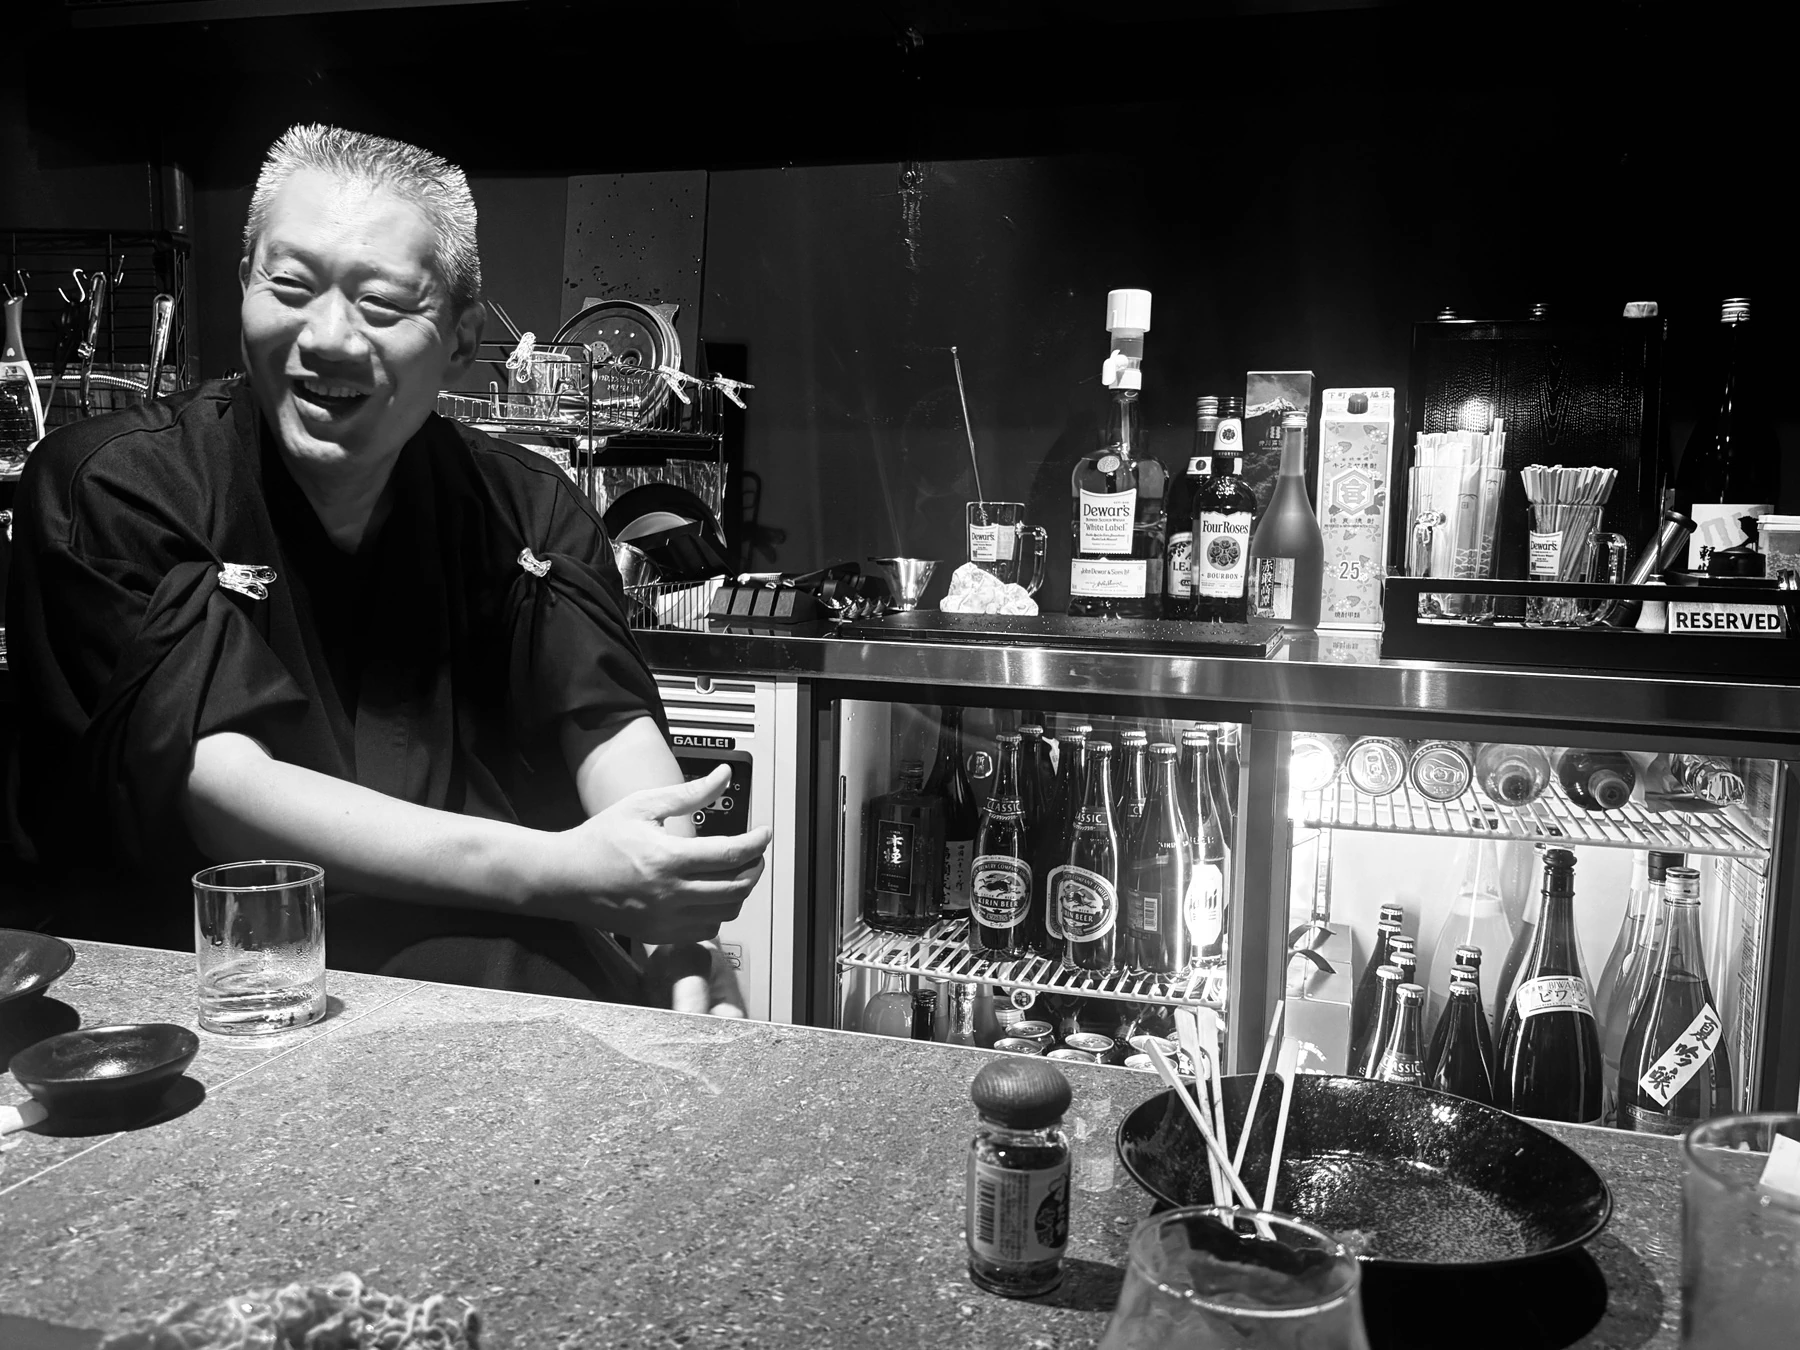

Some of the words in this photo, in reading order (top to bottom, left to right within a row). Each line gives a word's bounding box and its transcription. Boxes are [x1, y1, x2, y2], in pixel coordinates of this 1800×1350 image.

[1083, 504, 1131, 517] Dewar's
[1202, 520, 1222, 533] Four
[1223, 521, 1249, 534] Roses
[972, 531, 995, 541] Dewar's
[1530, 540, 1558, 551] Dewar's
[1206, 572, 1239, 580] BOURBON
[1339, 561, 1360, 580] 25
[1676, 611, 1781, 630] RESERVED
[673, 736, 729, 748] GALILEI
[987, 801, 1021, 812] CLASSIC
[978, 897, 999, 907] KIRIN
[1075, 913, 1093, 922] BEER
[1383, 1056, 1421, 1073] CASSIC
